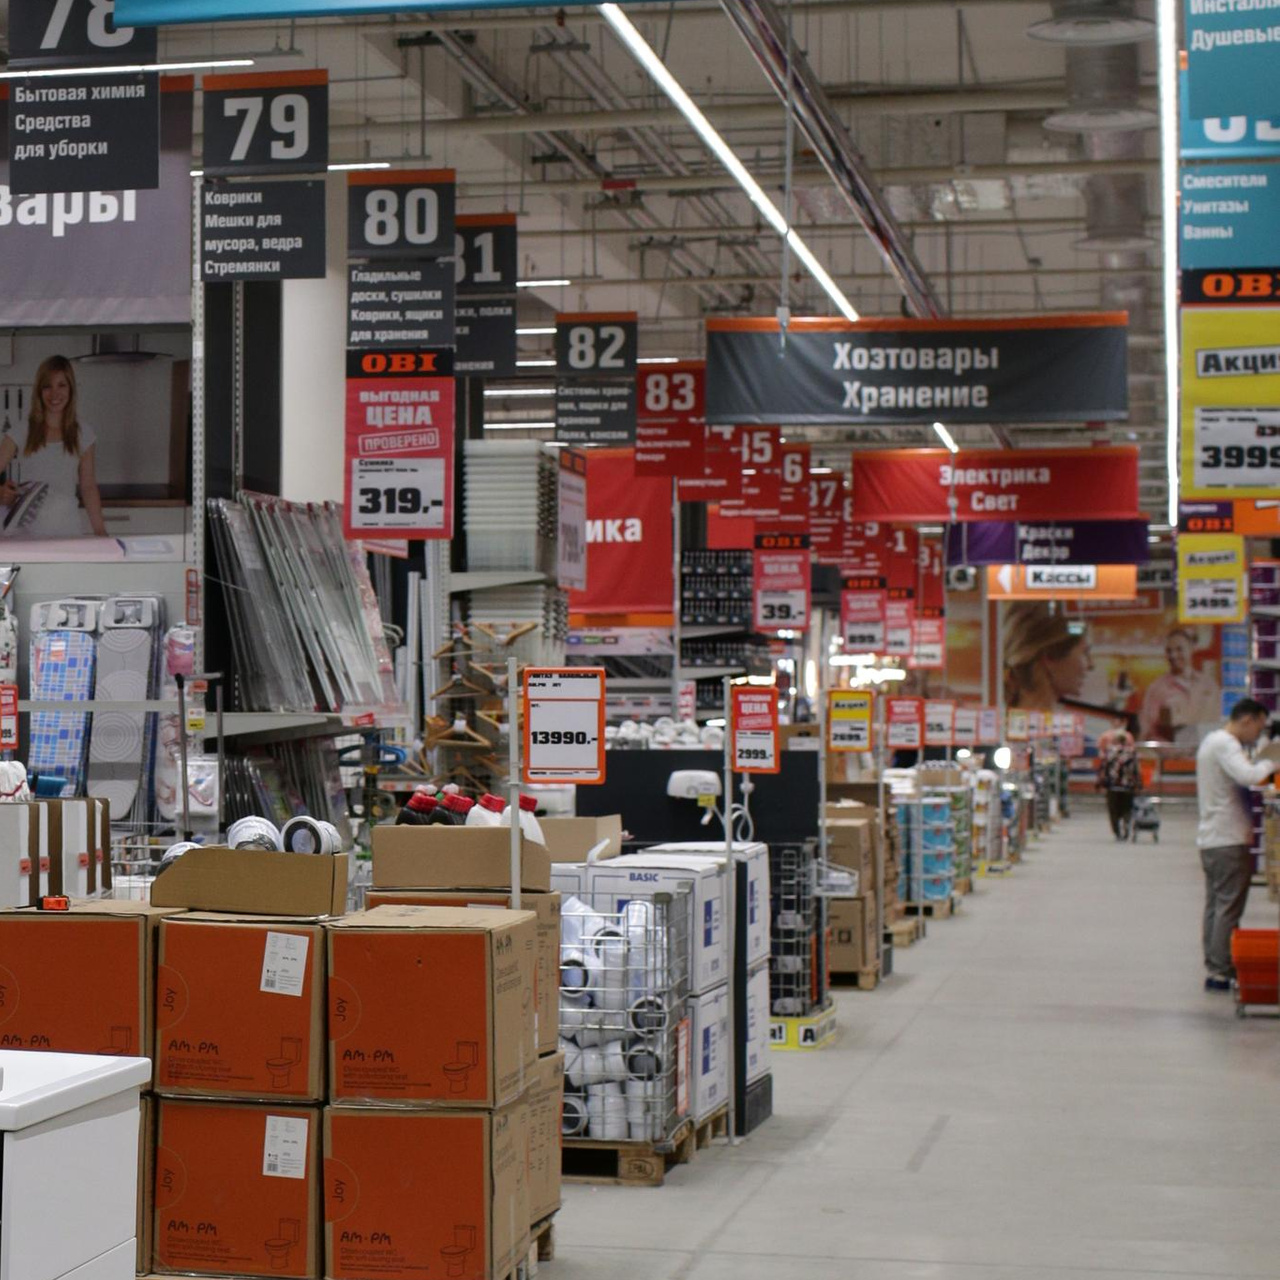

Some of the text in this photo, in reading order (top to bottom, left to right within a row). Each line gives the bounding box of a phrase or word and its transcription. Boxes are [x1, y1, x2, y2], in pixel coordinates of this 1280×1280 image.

[15, 85, 146, 103] Бытовая химия
[15, 114, 91, 134] Средства
[223, 93, 309, 162] 79
[14, 140, 108, 161] для уборки
[1183, 174, 1268, 190] Смесители
[205, 191, 263, 206] Коврики
[1183, 199, 1249, 215] Унитазы
[205, 214, 282, 228] Мешки для
[363, 187, 439, 246] 80
[1184, 225, 1234, 240] Ванны
[205, 237, 303, 254] мусора, ведра
[205, 260, 280, 276] Стремянки
[351, 270, 422, 284] Гладильные
[1201, 273, 1280, 298] OB
[351, 290, 442, 304] доски, сушилки
[351, 309, 403, 323] Коврики,
[405, 308, 444, 322] ящики
[350, 329, 429, 342] для хранения
[568, 325, 626, 370] 82
[361, 353, 438, 373] OBI
[832, 341, 999, 375] Хозтовары
[1202, 352, 1280, 375] Акци
[359, 390, 440, 404] ВЫГОДНАЯ
[645, 372, 696, 412] 83
[842, 381, 988, 413] Хранение
[365, 405, 433, 428] ЦЕНА
[938, 464, 1051, 487] Электрика
[970, 491, 1020, 511] Свет
[1186, 517, 1233, 531] OBI
[1018, 525, 1074, 541] Краски
[761, 536, 802, 547] OBI
[1021, 543, 1070, 560] Декор
[1031, 571, 1092, 585] Кассы
[531, 731, 598, 745] 13990.-
[629, 872, 659, 883] BASIC
